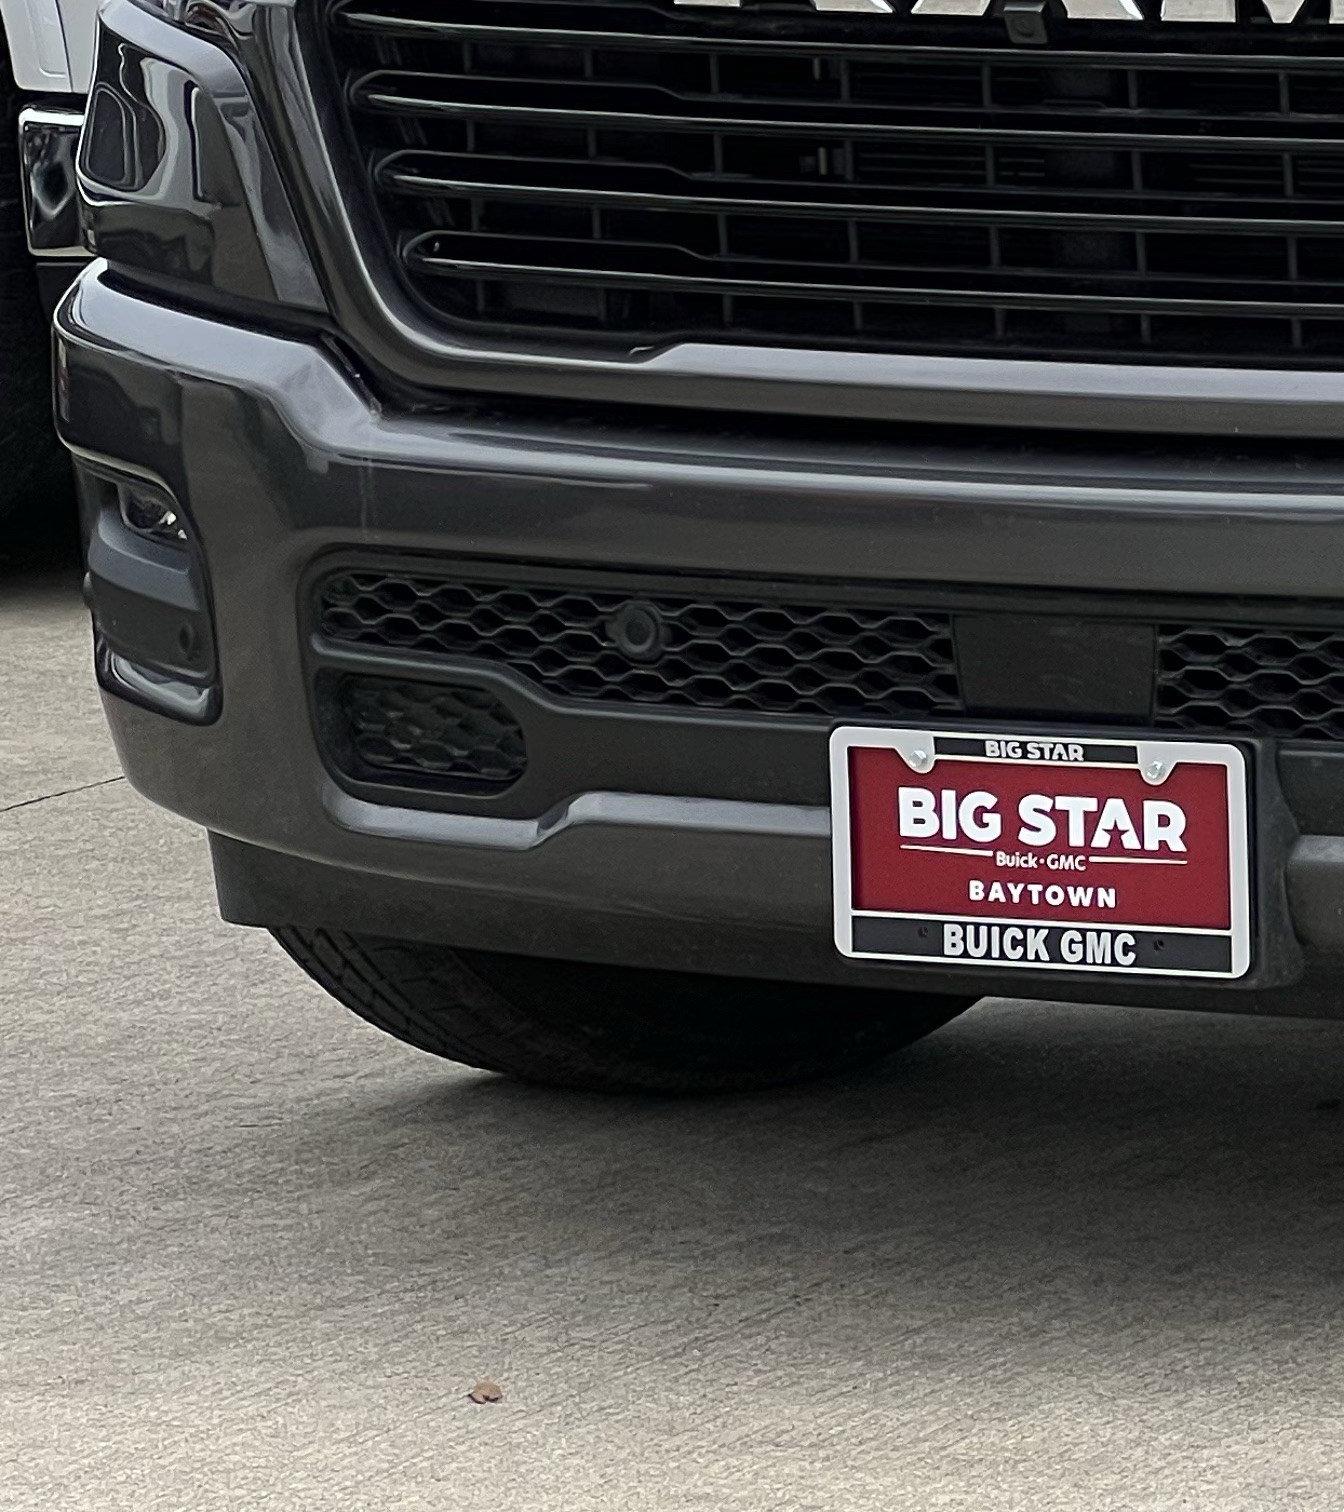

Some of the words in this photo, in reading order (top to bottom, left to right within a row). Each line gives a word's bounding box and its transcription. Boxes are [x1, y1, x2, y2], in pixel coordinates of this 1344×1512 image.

[985, 740, 1025, 760] BIG
[1027, 741, 1084, 762] STAR
[898, 786, 1001, 843] BIG
[1017, 794, 1188, 852] STAR
[995, 851, 1037, 869] Buick
[1046, 853, 1087, 872] GMC
[968, 879, 1117, 909] BAYTOWN
[943, 923, 1050, 962] BUICK
[1060, 929, 1137, 967] GMC
